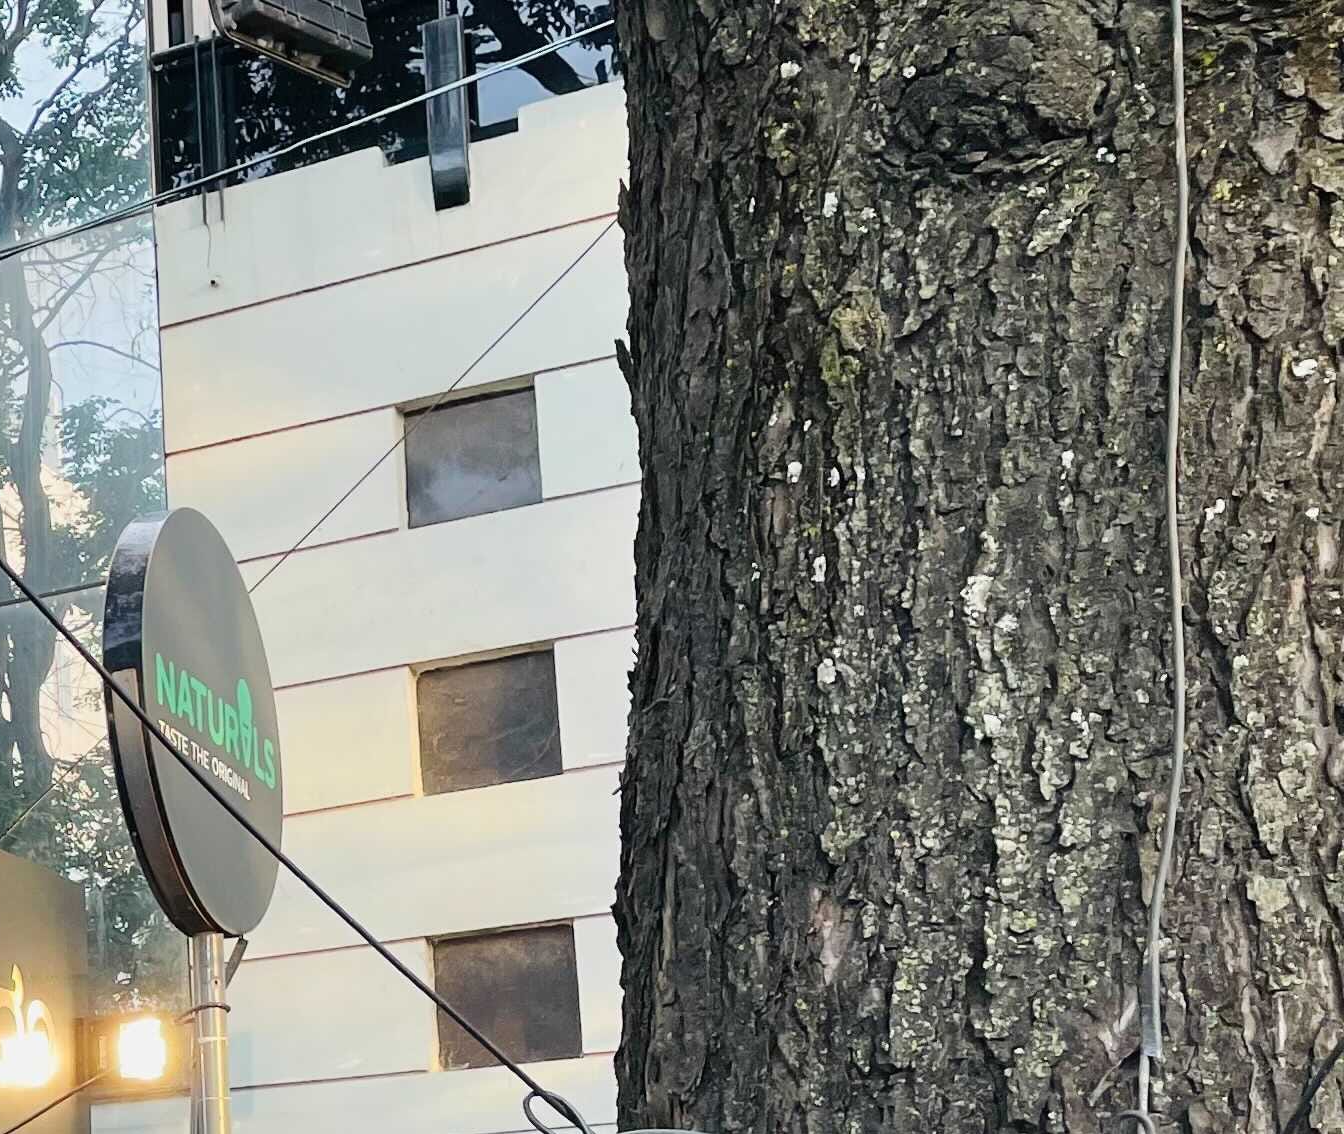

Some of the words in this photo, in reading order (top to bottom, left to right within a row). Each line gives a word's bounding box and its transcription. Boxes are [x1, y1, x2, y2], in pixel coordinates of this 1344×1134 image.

[155, 652, 276, 789] NATURALS
[158, 719, 189, 756] TASTE
[191, 738, 210, 769] THE
[211, 756, 251, 800] ORIGINAL
